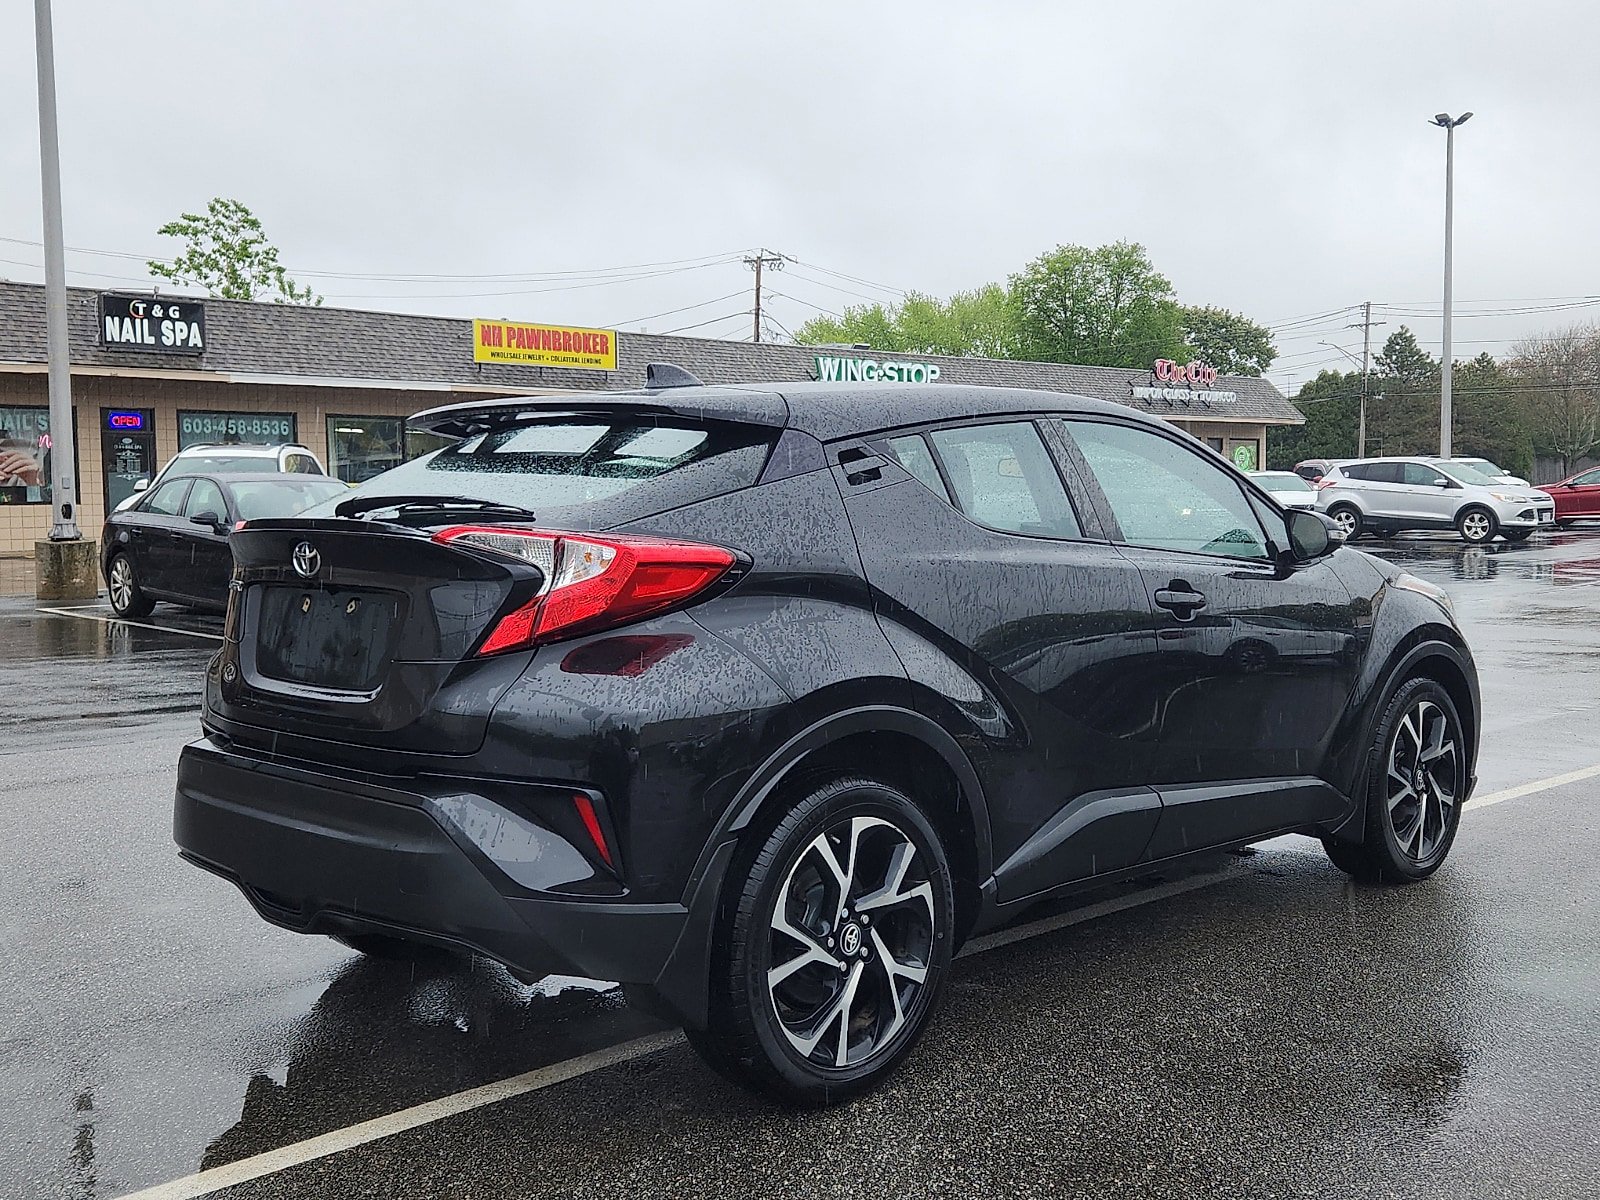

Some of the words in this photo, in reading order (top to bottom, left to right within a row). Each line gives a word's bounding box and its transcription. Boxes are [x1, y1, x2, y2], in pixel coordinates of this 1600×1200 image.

[133, 302, 147, 317] T
[151, 304, 164, 318] &
[168, 305, 180, 319] G
[105, 315, 156, 345] NAIL
[160, 319, 203, 348] SPA
[480, 324, 503, 347] NH
[506, 326, 609, 355] PAWNBROKER
[490, 351, 522, 361] WHOLESALE
[522, 353, 545, 362] JEWELRY
[550, 355, 580, 364] COLLATERAL
[581, 357, 602, 365] LENDING
[1155, 359, 1187, 385] The
[1187, 360, 1218, 387] City
[111, 415, 141, 427] OPEN
[182, 417, 290, 436] 603-458-8536
